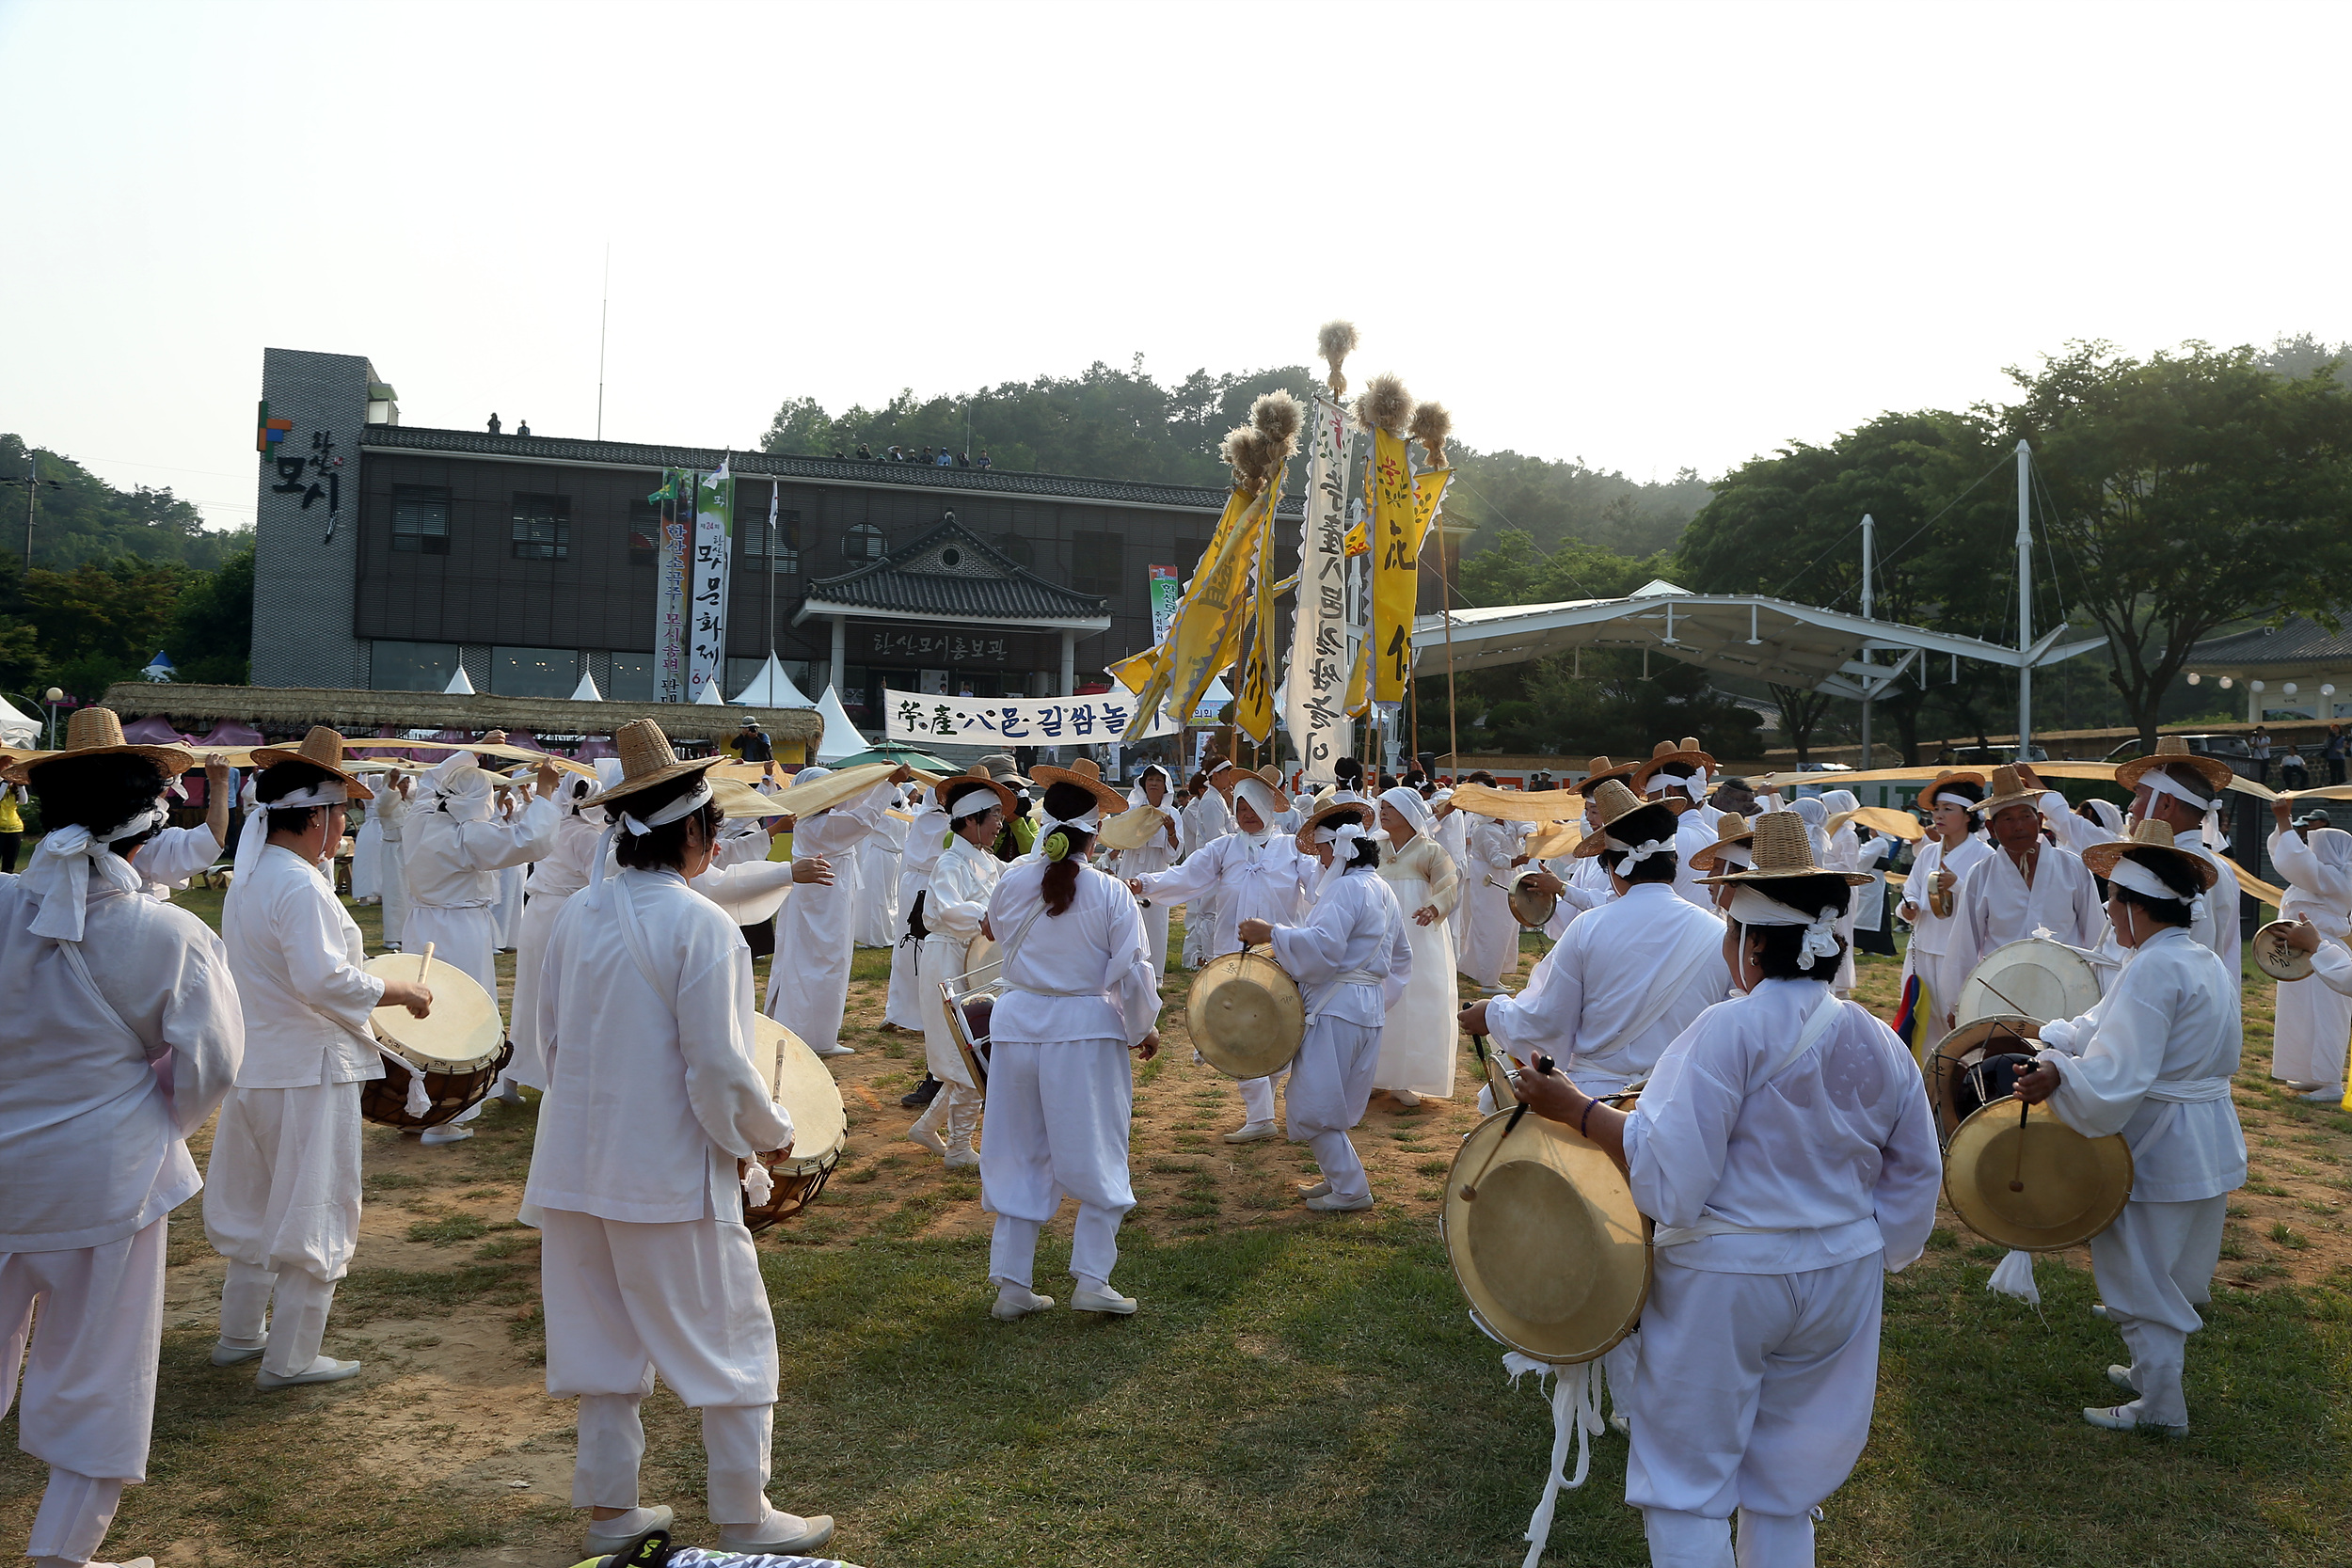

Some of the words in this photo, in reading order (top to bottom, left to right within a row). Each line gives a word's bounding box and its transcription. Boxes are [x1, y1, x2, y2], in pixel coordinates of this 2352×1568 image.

[272, 456, 339, 545] 모시
[697, 545, 728, 570] 모시
[696, 577, 723, 670] 문화제
